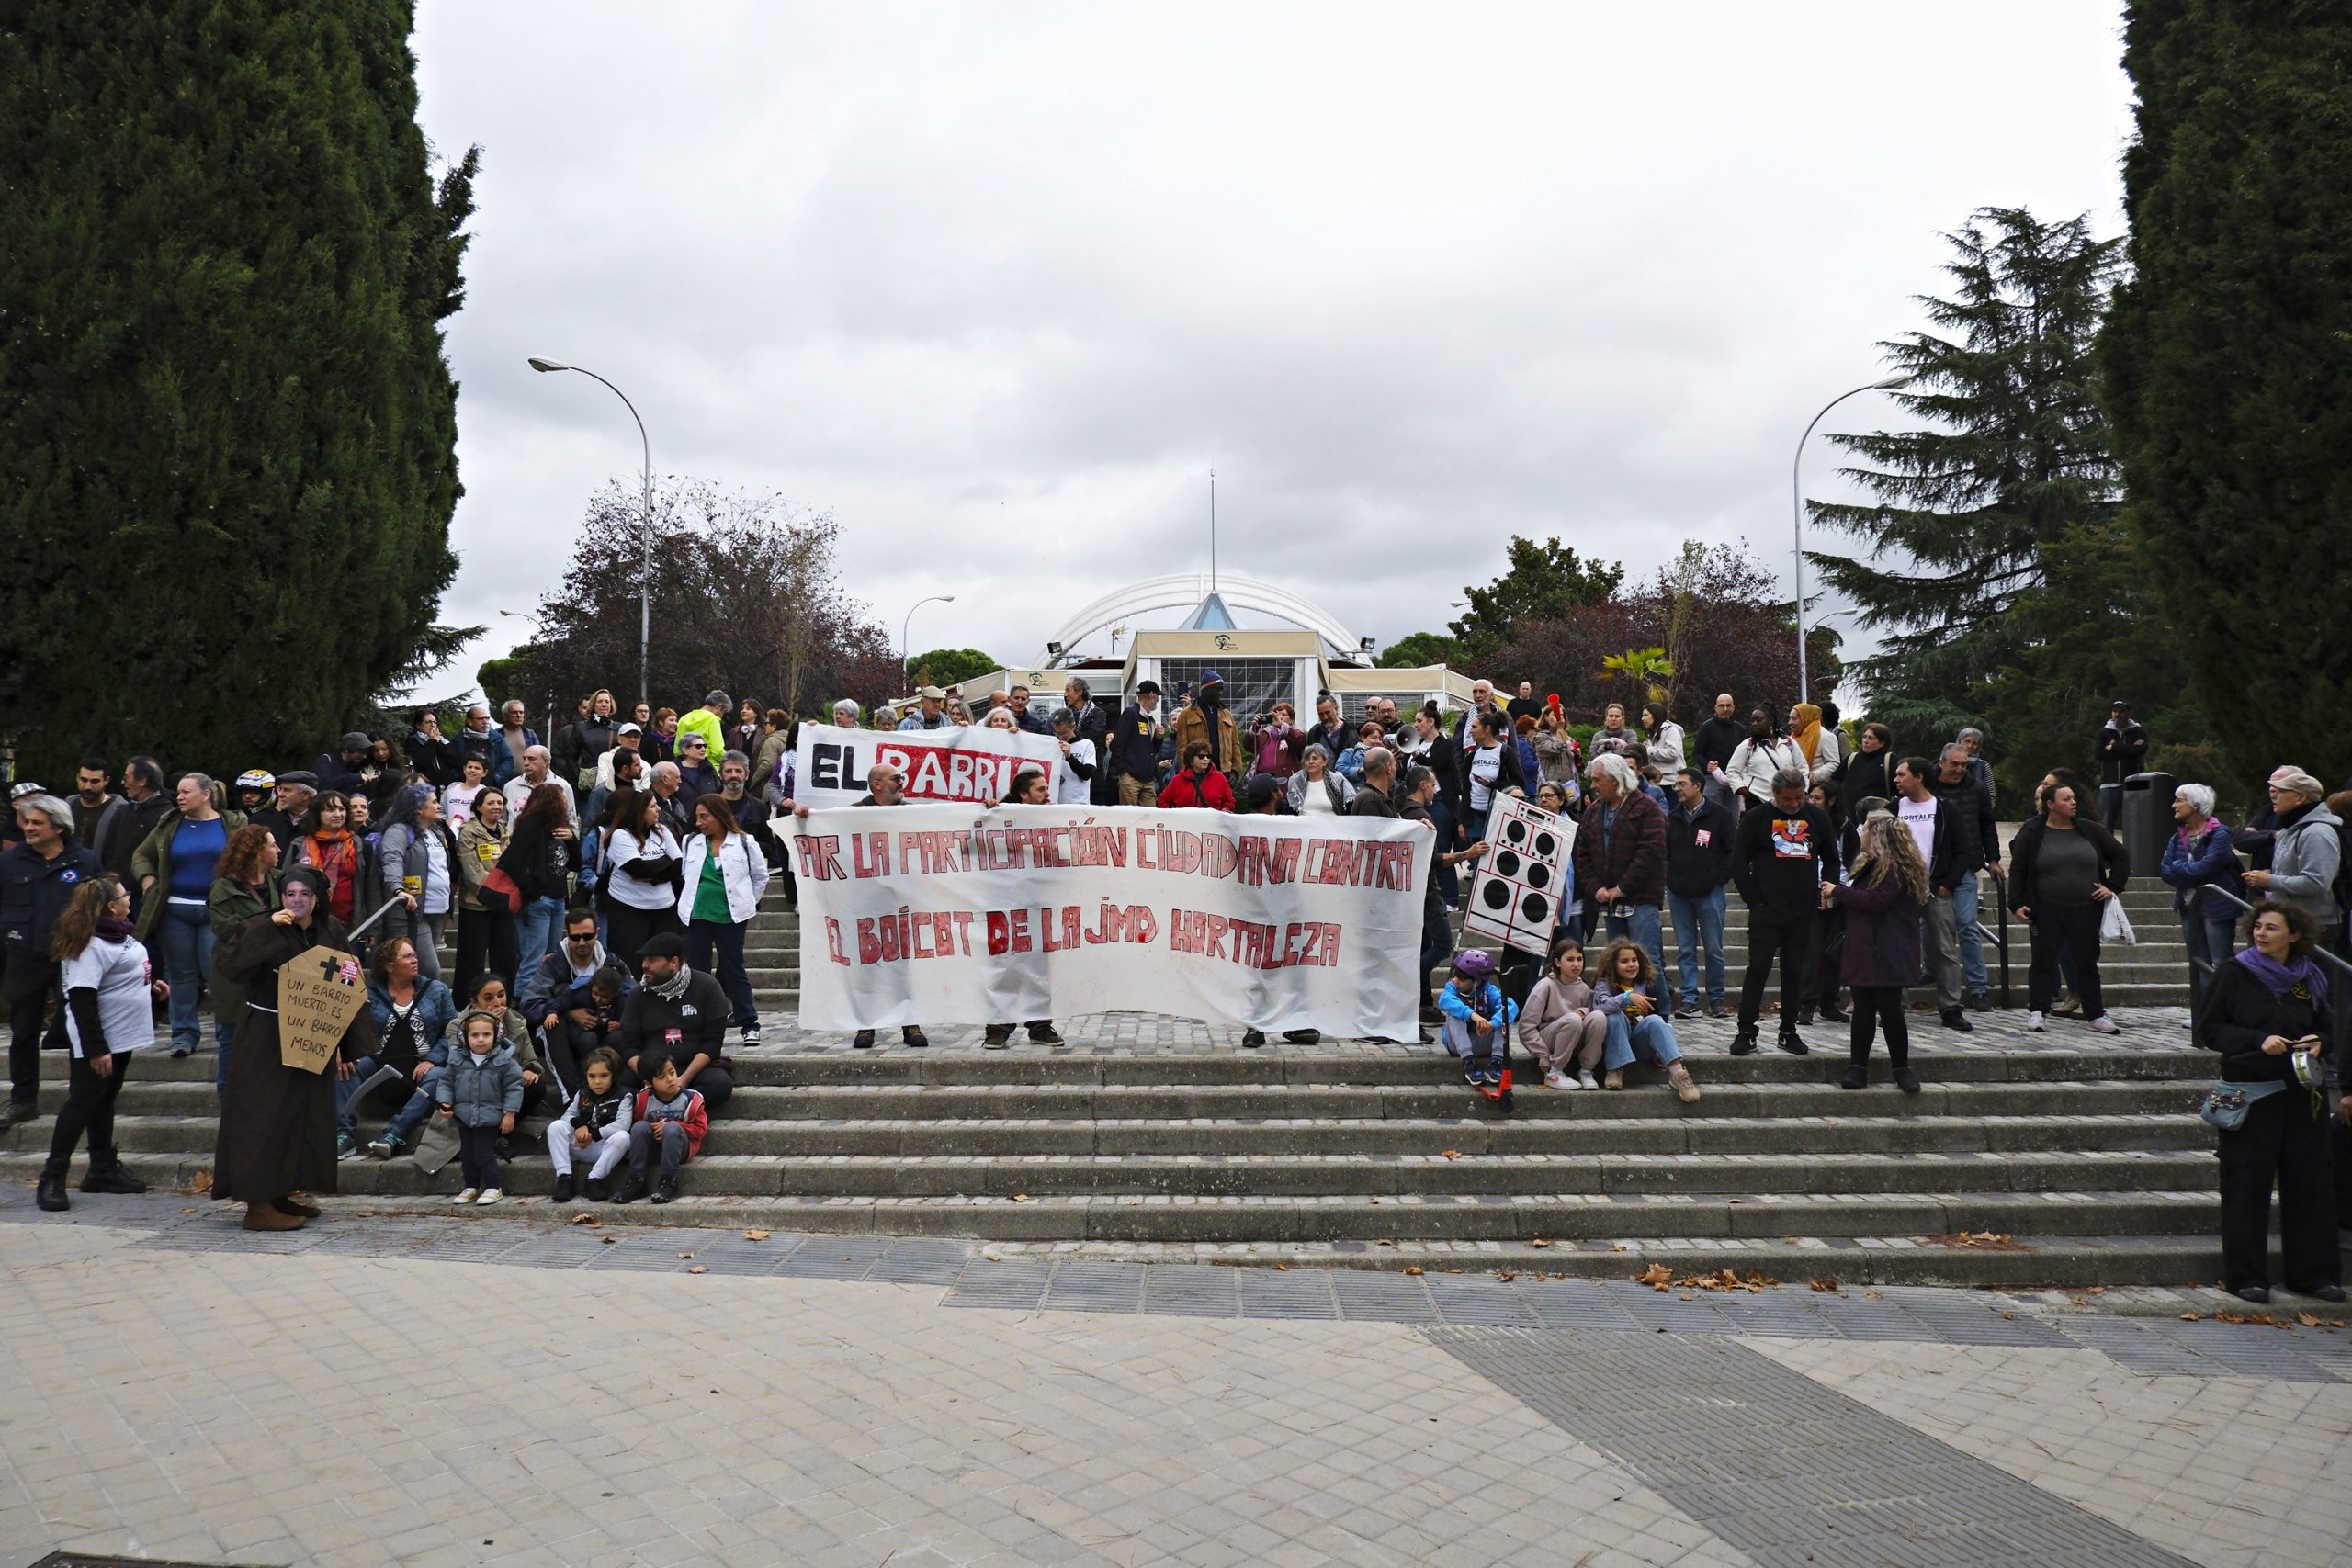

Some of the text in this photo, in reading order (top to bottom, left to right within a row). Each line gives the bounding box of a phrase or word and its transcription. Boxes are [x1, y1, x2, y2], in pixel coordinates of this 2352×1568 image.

[811, 742, 867, 791] EL
[852, 832, 890, 879] LA
[1302, 838, 1415, 892] CONTRA
[986, 908, 1033, 956] DE
[1042, 906, 1081, 953] LA
[1170, 908, 1342, 970] HORTALEZA
[288, 978, 352, 1005] UN BARRIO
[331, 1006, 343, 1019] ES
[287, 1015, 342, 1038] UN BARRIO
[290, 1036, 328, 1057] MENOS
